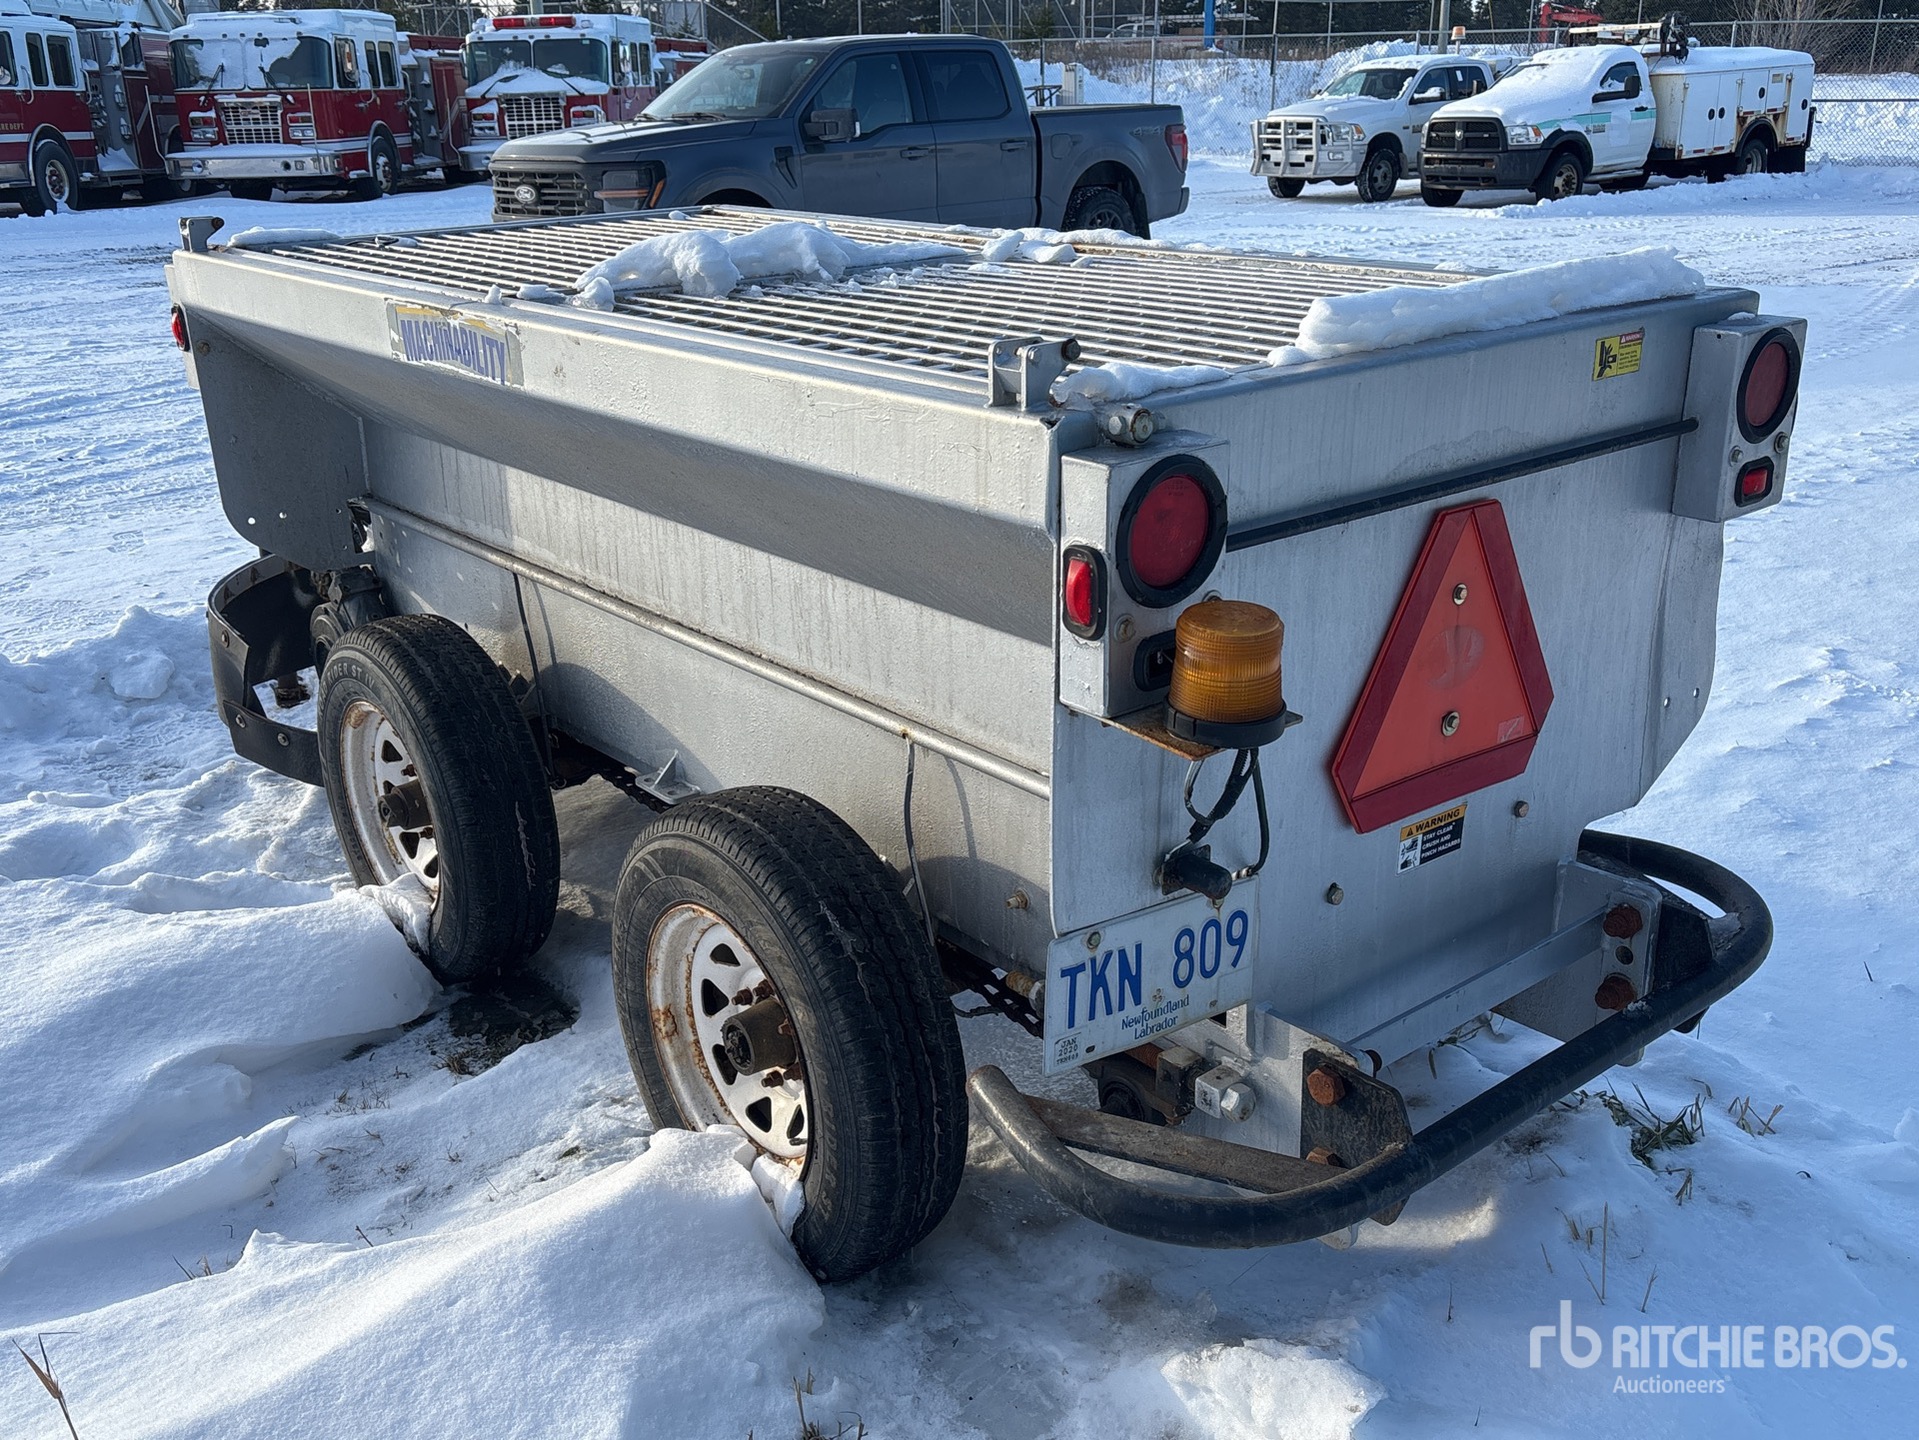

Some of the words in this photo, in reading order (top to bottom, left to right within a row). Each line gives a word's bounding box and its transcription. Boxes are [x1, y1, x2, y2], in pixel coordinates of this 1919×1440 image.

[351, 664, 363, 680] ST
[1415, 809, 1460, 832] WARNING
[1422, 839, 1440, 850] CRUSH
[1440, 833, 1452, 843] AND
[1423, 832, 1436, 841] STAY
[1436, 825, 1453, 836] CLEAR
[1421, 848, 1437, 858] PINCH
[1437, 838, 1461, 851] HAZARDS
[1060, 943, 1143, 1030] TKN
[1172, 909, 1249, 989] 809
[1121, 994, 1190, 1031] Newfoundland
[1133, 1015, 1178, 1040] Labrador
[1058, 1043, 1079, 1057] 2020
[1060, 1037, 1078, 1049] JAN
